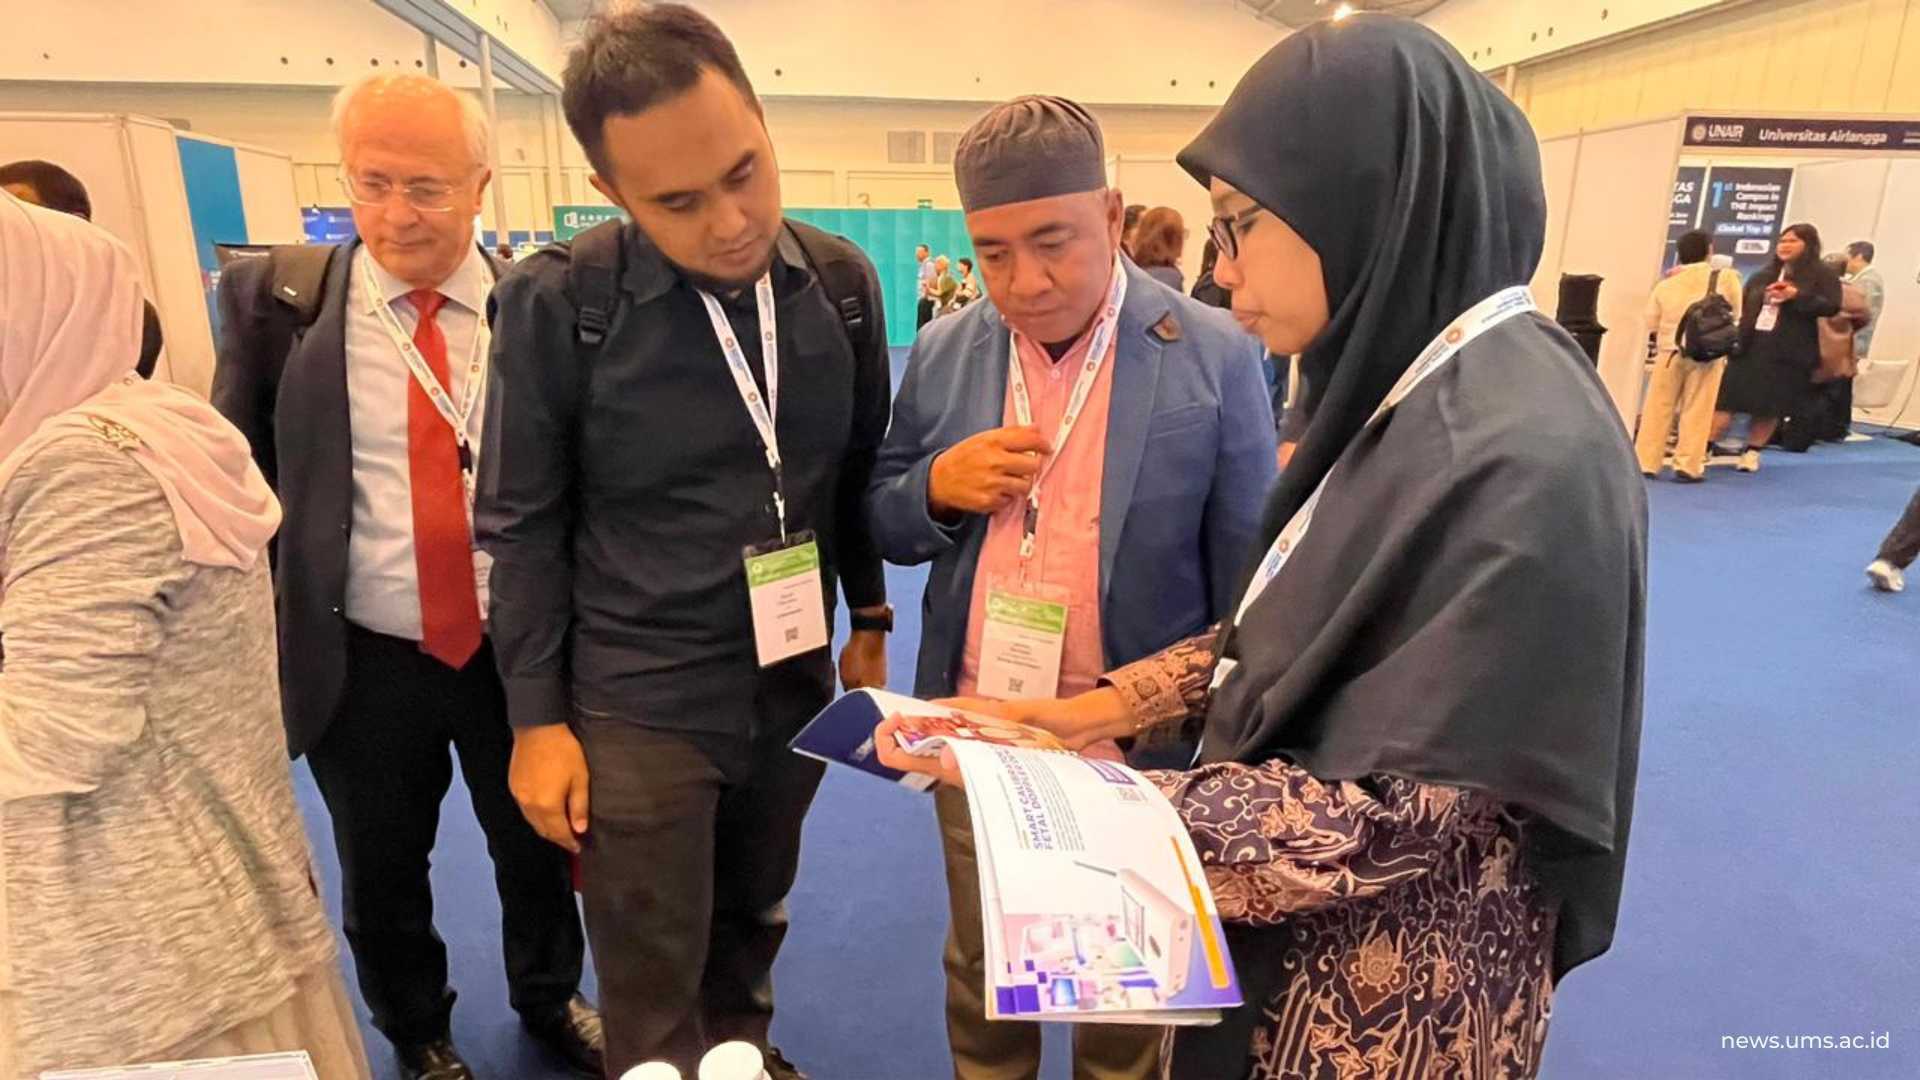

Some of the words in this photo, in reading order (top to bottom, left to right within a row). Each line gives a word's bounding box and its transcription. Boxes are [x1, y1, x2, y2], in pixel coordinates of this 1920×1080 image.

[1708, 124, 1744, 139] UNAIR
[1759, 128, 1826, 142] Universitas
[1827, 130, 1888, 145] Airlangga
[1736, 212, 1775, 222] Rankings
[1717, 223, 1745, 233] Global
[1023, 806, 1043, 850] SMART
[1035, 812, 1054, 850] FETAL
